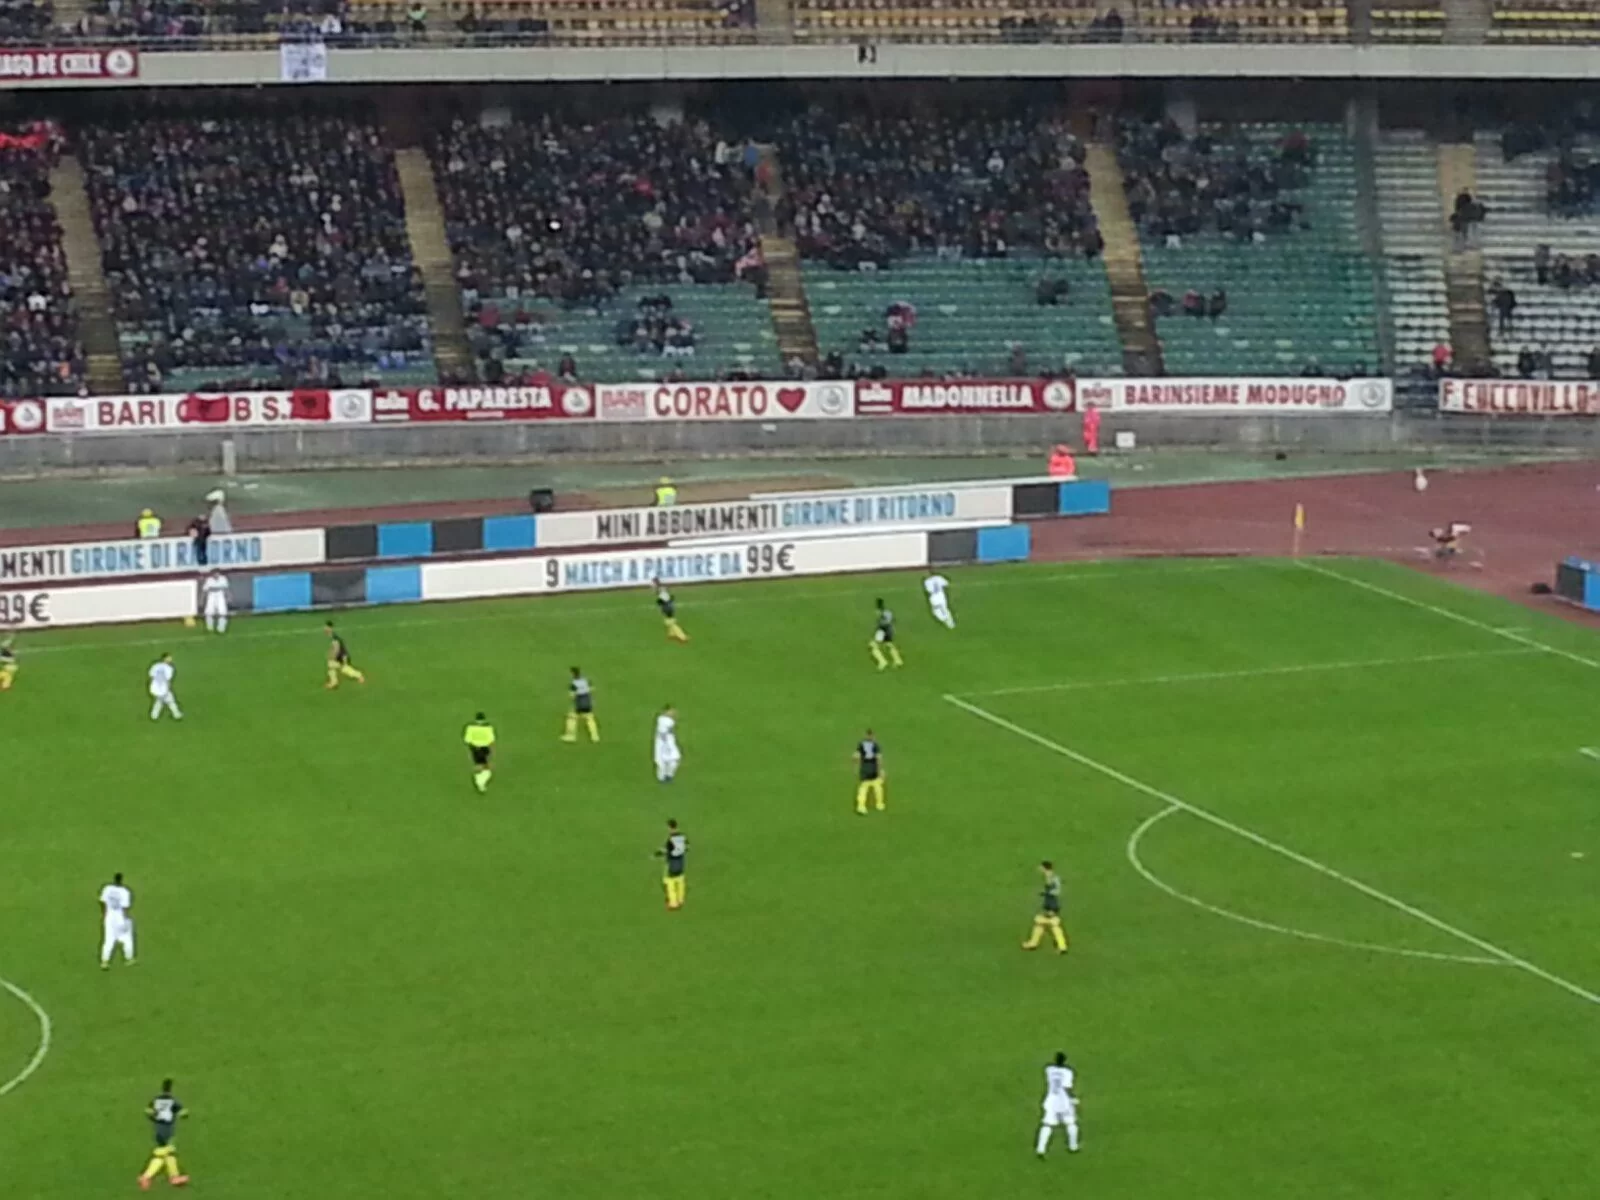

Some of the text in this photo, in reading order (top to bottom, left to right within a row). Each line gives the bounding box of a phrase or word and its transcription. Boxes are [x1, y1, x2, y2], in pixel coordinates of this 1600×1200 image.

[418, 389, 440, 411] G.
[444, 386, 553, 410] PAPARESTA
[653, 385, 768, 417] CORATO
[901, 385, 1034, 407] MADONNELLA
[1124, 383, 1347, 406] BARINSIEME MODUGNO
[98, 400, 165, 426] BARI
[597, 491, 956, 540] MINI ABBONAMENTI GIRONE DI RITORNO
[70, 543, 145, 574] GIRONE
[150, 542, 171, 569] DI
[546, 543, 796, 588] 9 MATCH A PARTIRE DA 99€
